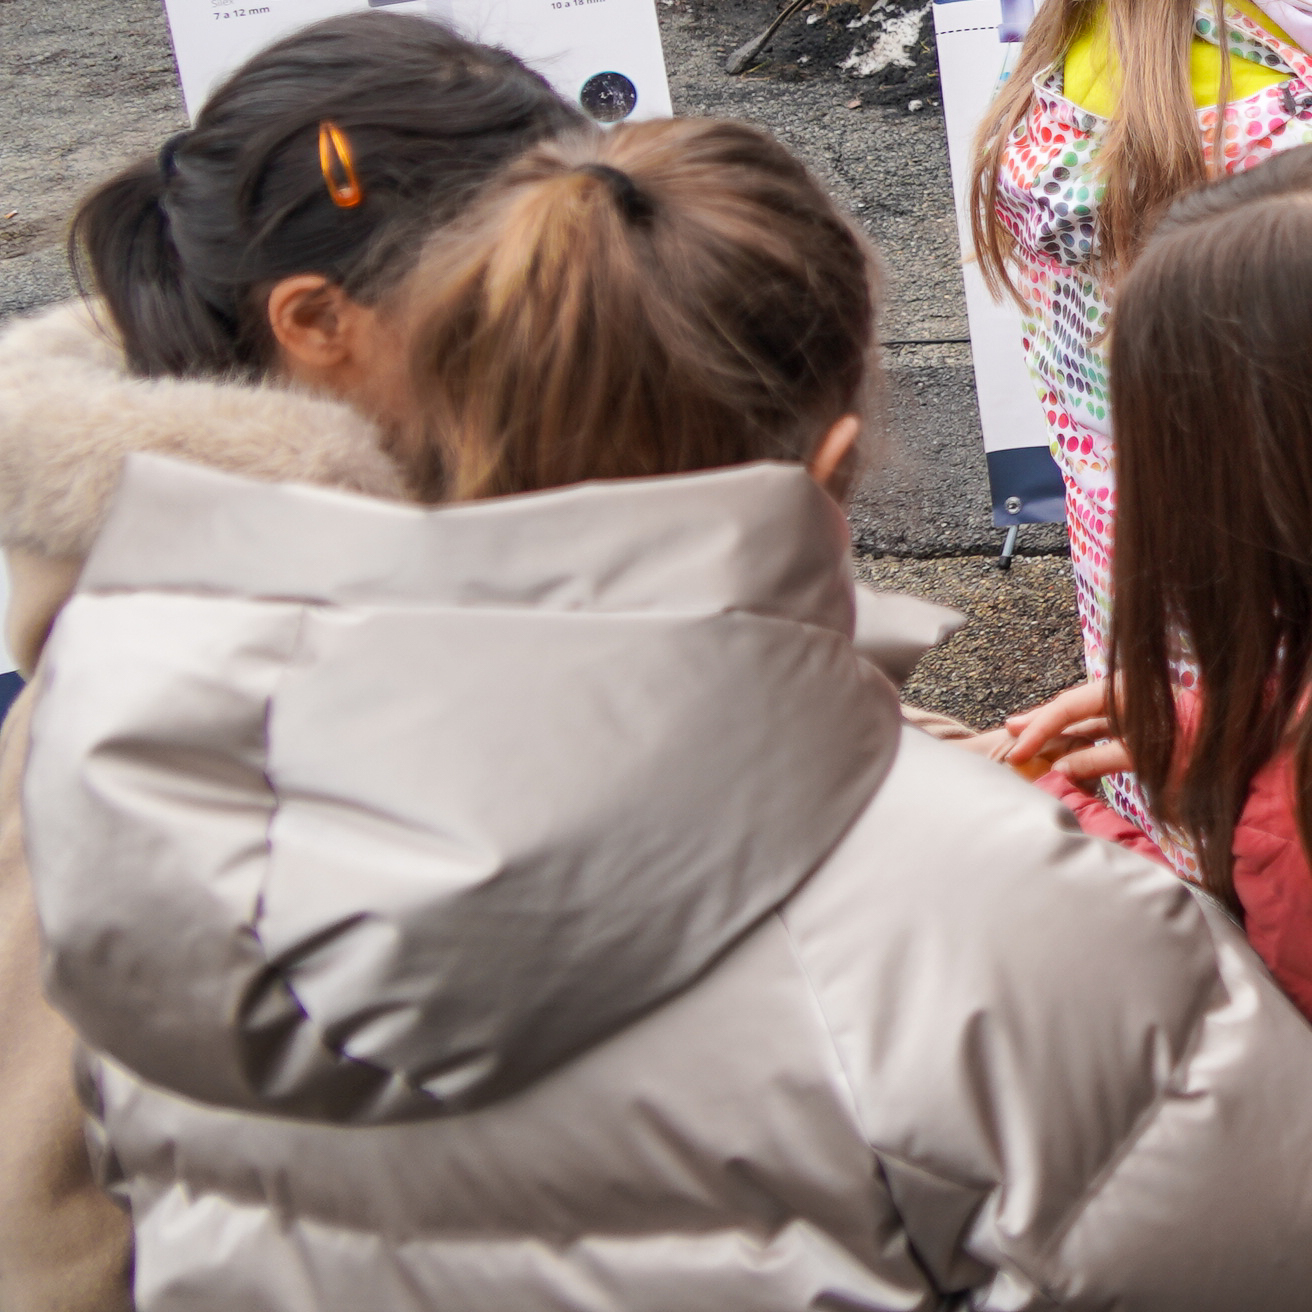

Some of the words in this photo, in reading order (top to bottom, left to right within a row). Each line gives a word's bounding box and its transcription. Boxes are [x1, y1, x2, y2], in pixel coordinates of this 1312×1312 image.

[213, 12, 219, 20] 7
[223, 11, 230, 19] a
[233, 8, 246, 18] 12
[248, 5, 270, 15] mm
